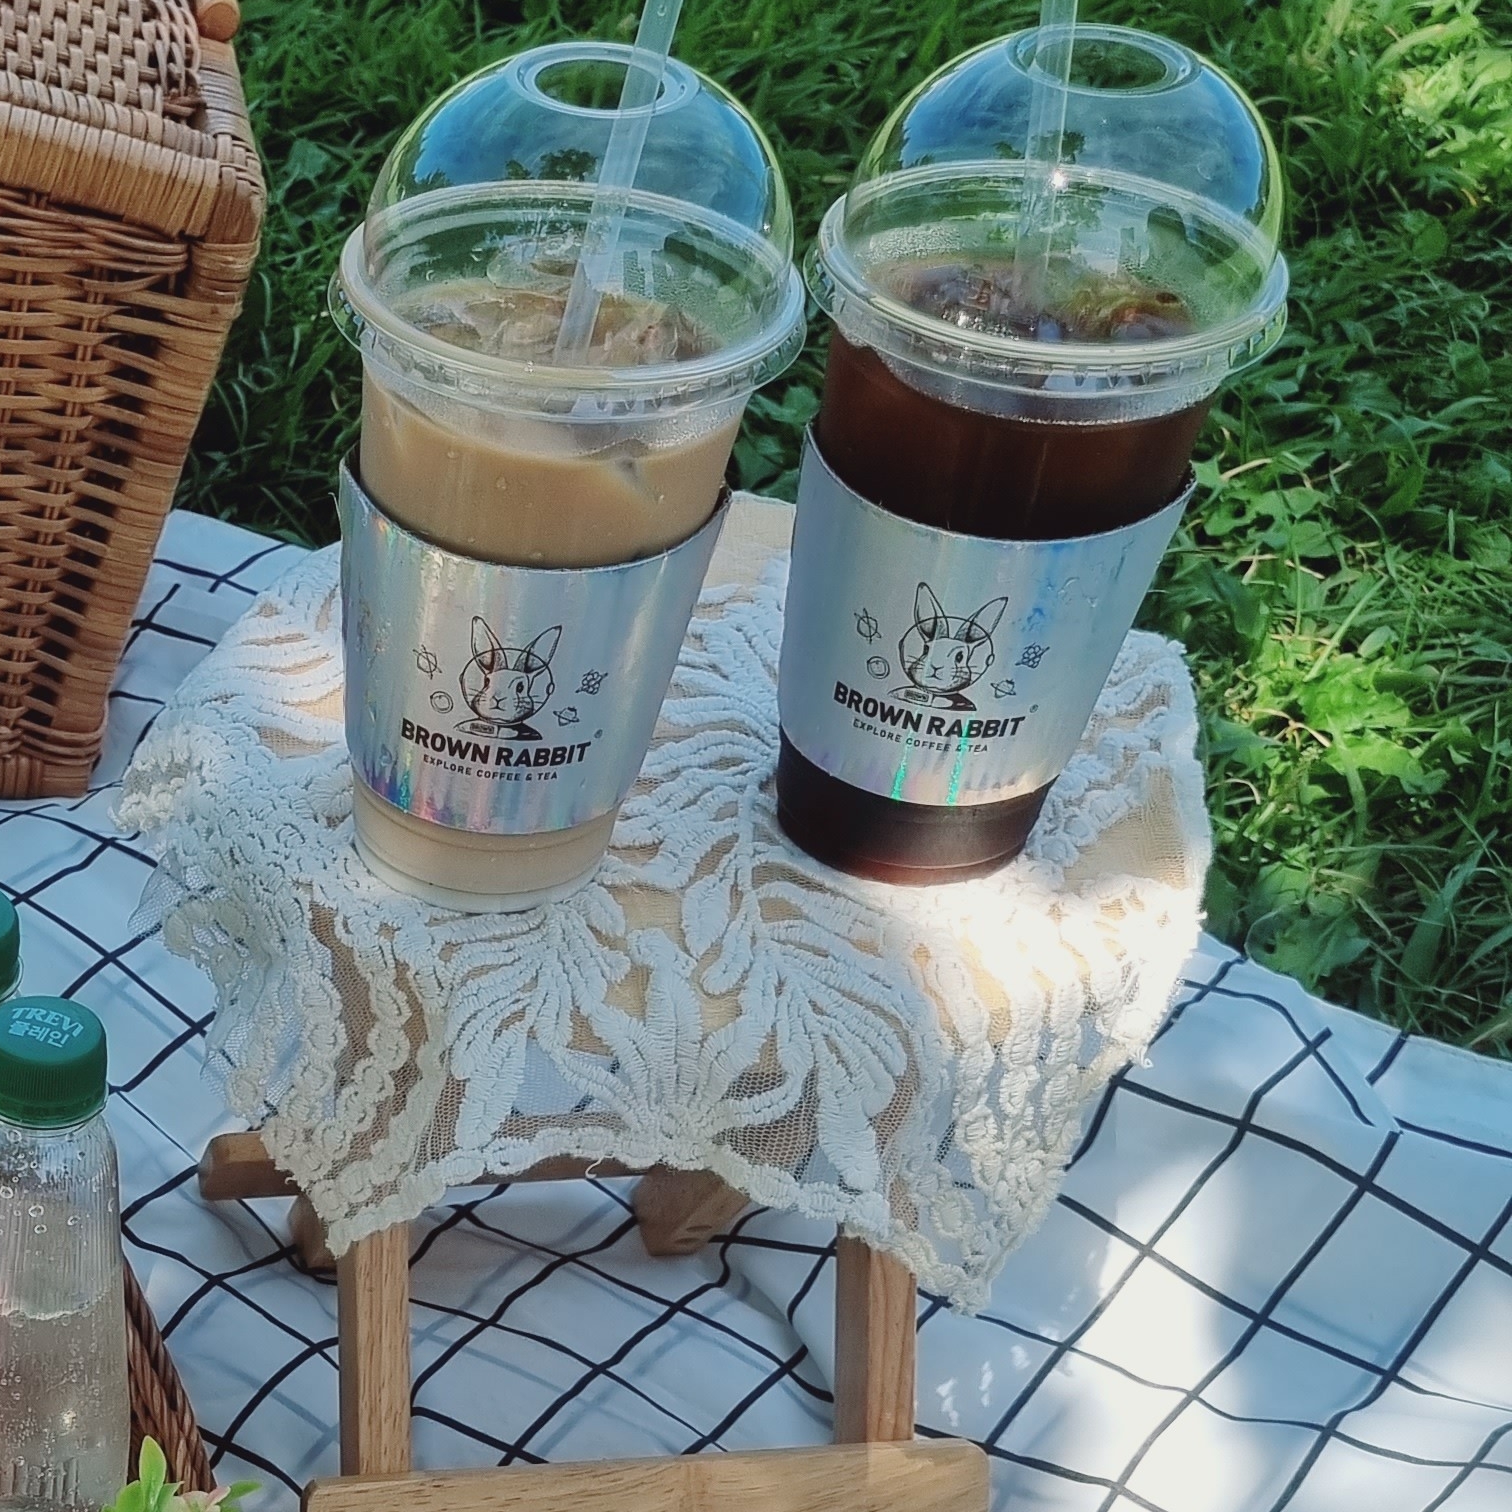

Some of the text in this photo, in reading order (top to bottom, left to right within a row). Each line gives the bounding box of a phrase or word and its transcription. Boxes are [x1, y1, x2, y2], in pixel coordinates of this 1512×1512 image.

[833, 680, 1026, 739] BROWN RABBIT
[401, 717, 592, 768] BROWN RABBIT
[852, 718, 902, 743] EXPLORE
[905, 737, 952, 752] COFFEE
[422, 753, 558, 782] EXPLORE COFFEE & TEA
[8, 1020, 70, 1048] 플레인
[11, 1007, 84, 1037] TREVI
